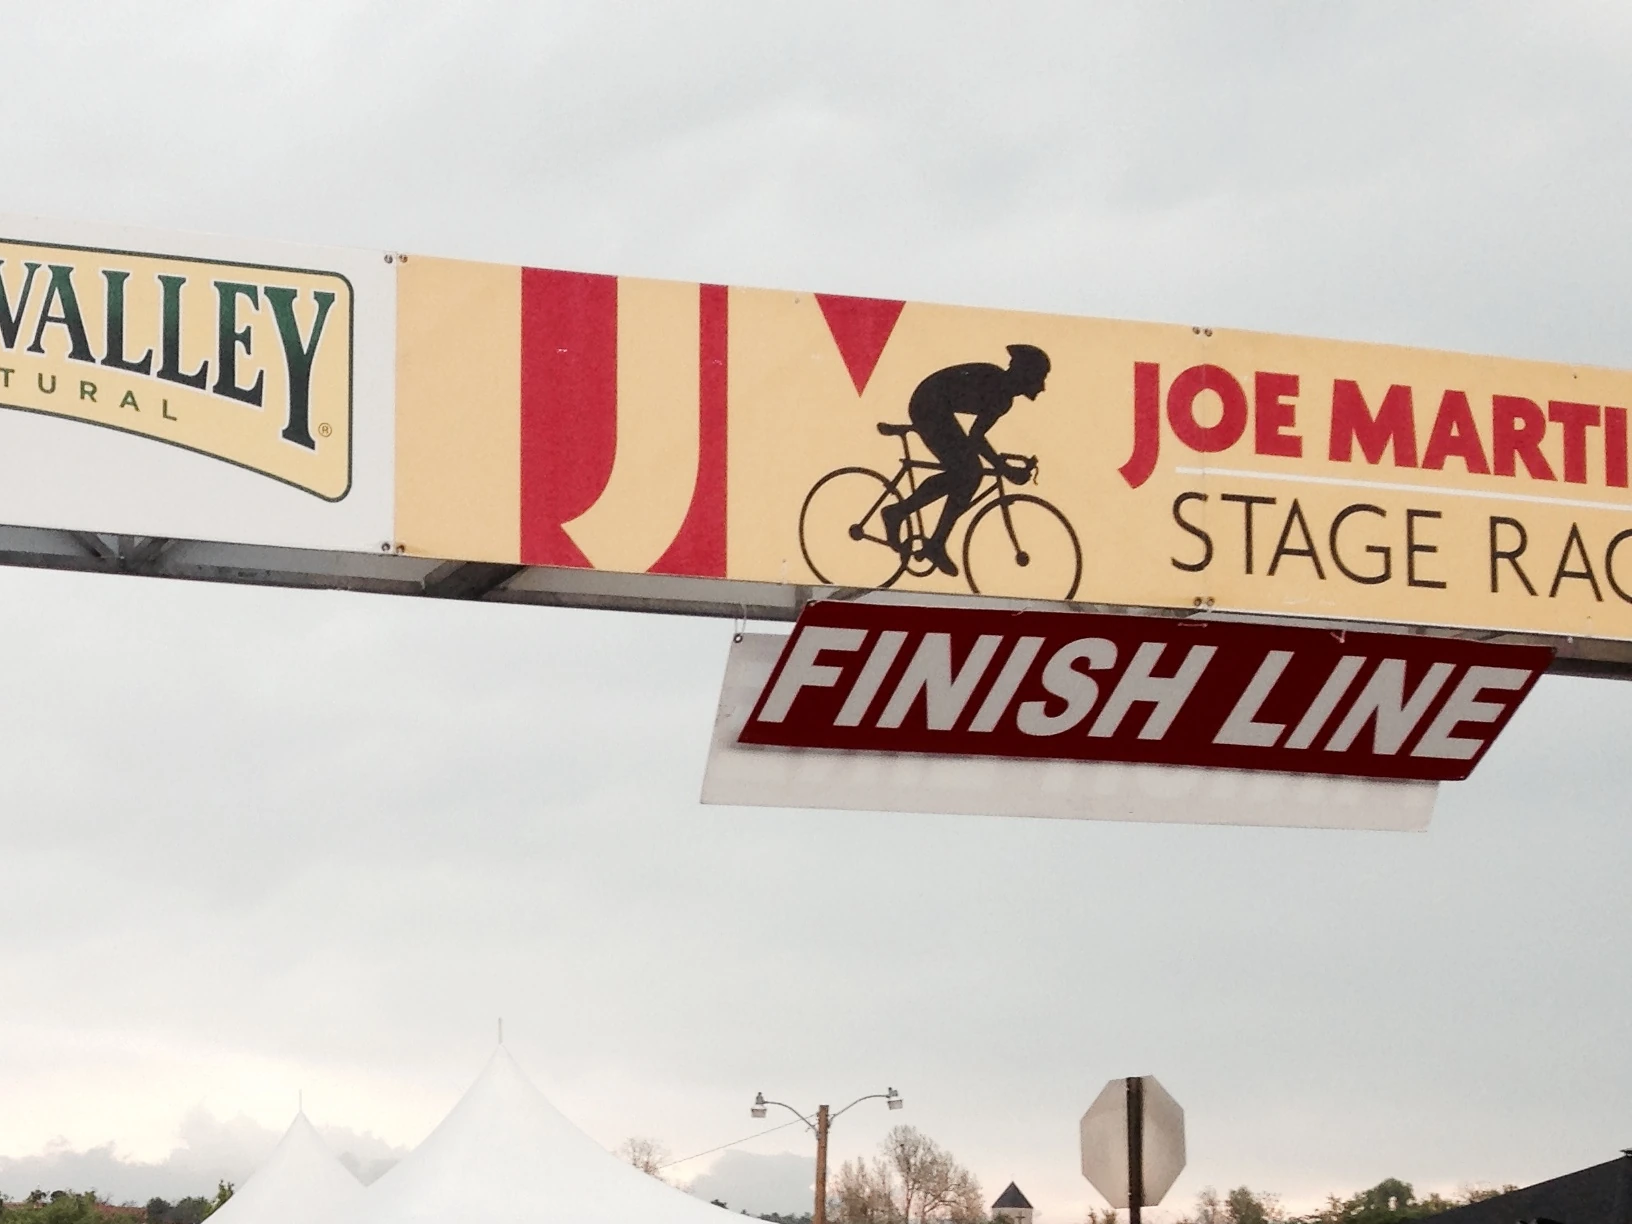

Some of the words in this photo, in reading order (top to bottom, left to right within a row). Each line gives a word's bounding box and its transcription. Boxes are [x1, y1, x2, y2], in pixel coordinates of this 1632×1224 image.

[1118, 361, 1303, 489] JOE
[1328, 378, 1629, 489] MARTI
[1170, 491, 1447, 590] STAGE
[757, 626, 1218, 741] FINISH
[1213, 649, 1532, 761] LINE
